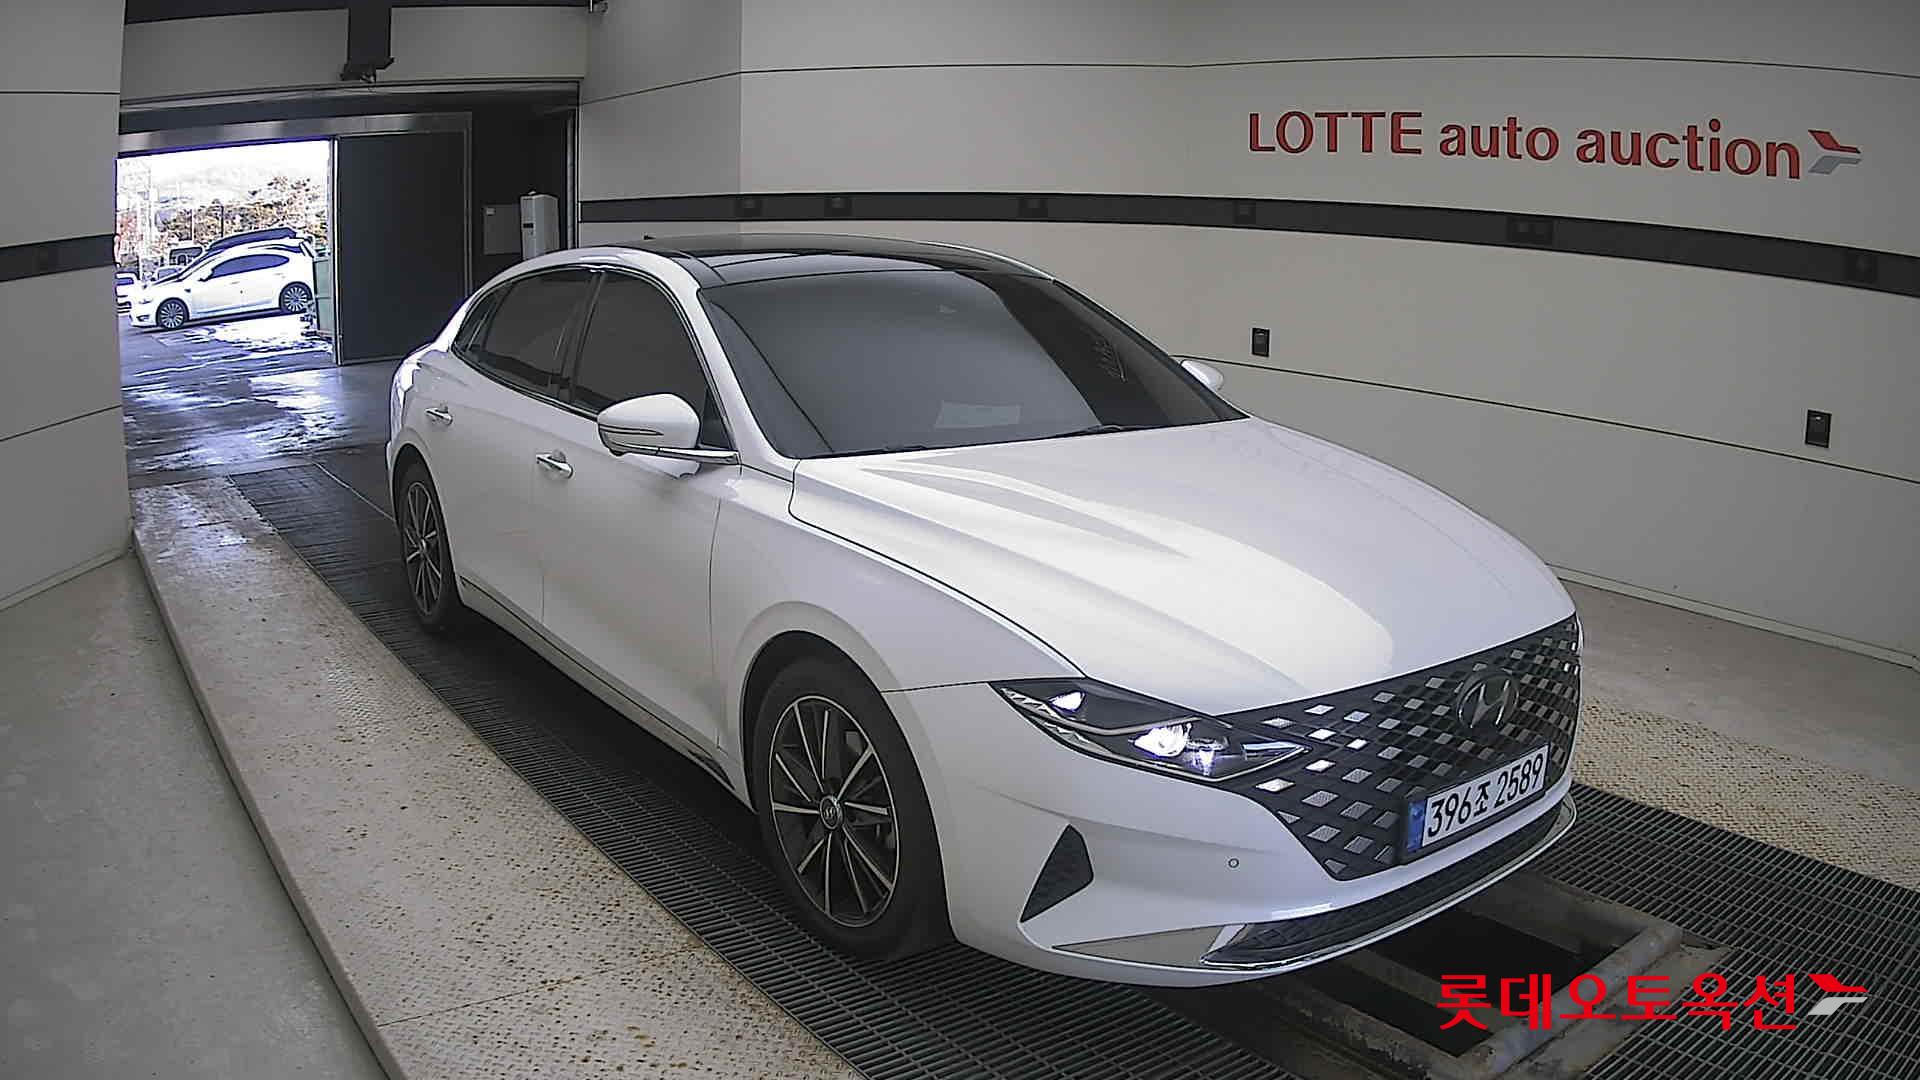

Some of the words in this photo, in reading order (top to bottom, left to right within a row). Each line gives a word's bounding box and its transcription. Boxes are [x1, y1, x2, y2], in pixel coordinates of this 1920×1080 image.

[1248, 111, 1422, 155] LOTTE
[1439, 117, 1560, 161] auto
[1575, 119, 1801, 179] auction
[1493, 752, 1544, 809] 2589
